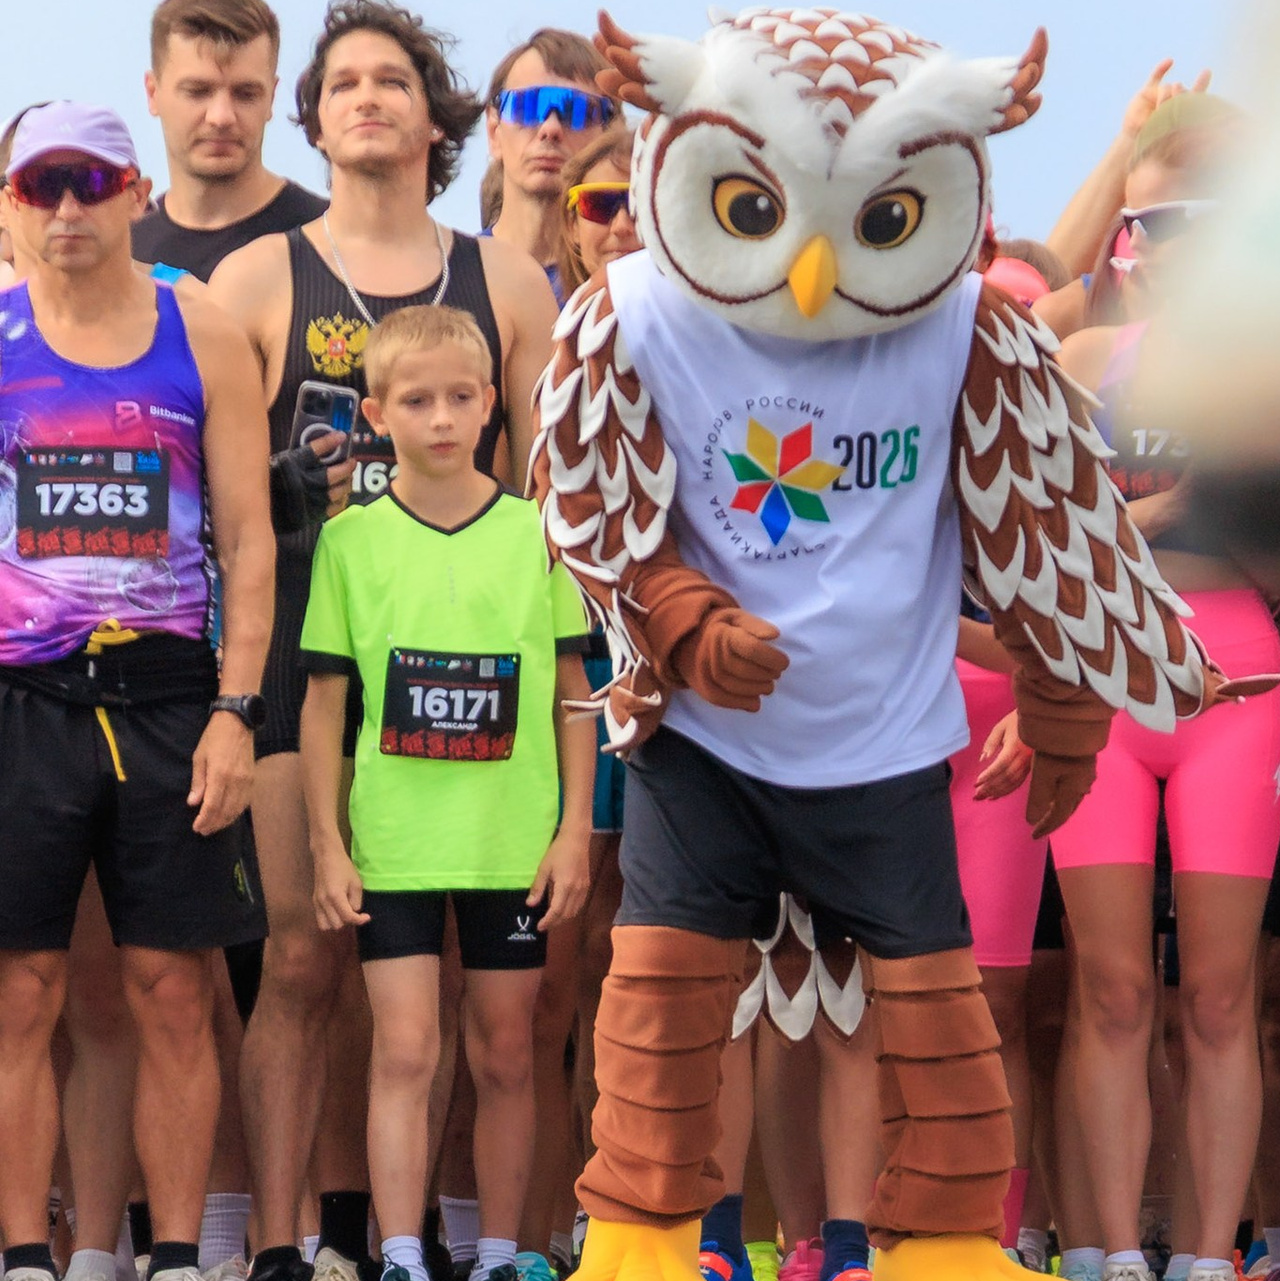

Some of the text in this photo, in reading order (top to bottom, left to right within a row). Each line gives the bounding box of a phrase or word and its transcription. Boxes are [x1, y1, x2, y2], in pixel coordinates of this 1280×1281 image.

[149, 405, 196, 426] Bitbanker
[745, 395, 826, 420] РОССИИ
[831, 423, 921, 492] 2026
[35, 483, 150, 517] 17363
[408, 685, 500, 721] 16171
[431, 720, 478, 731] АЛЕКСАНДР
